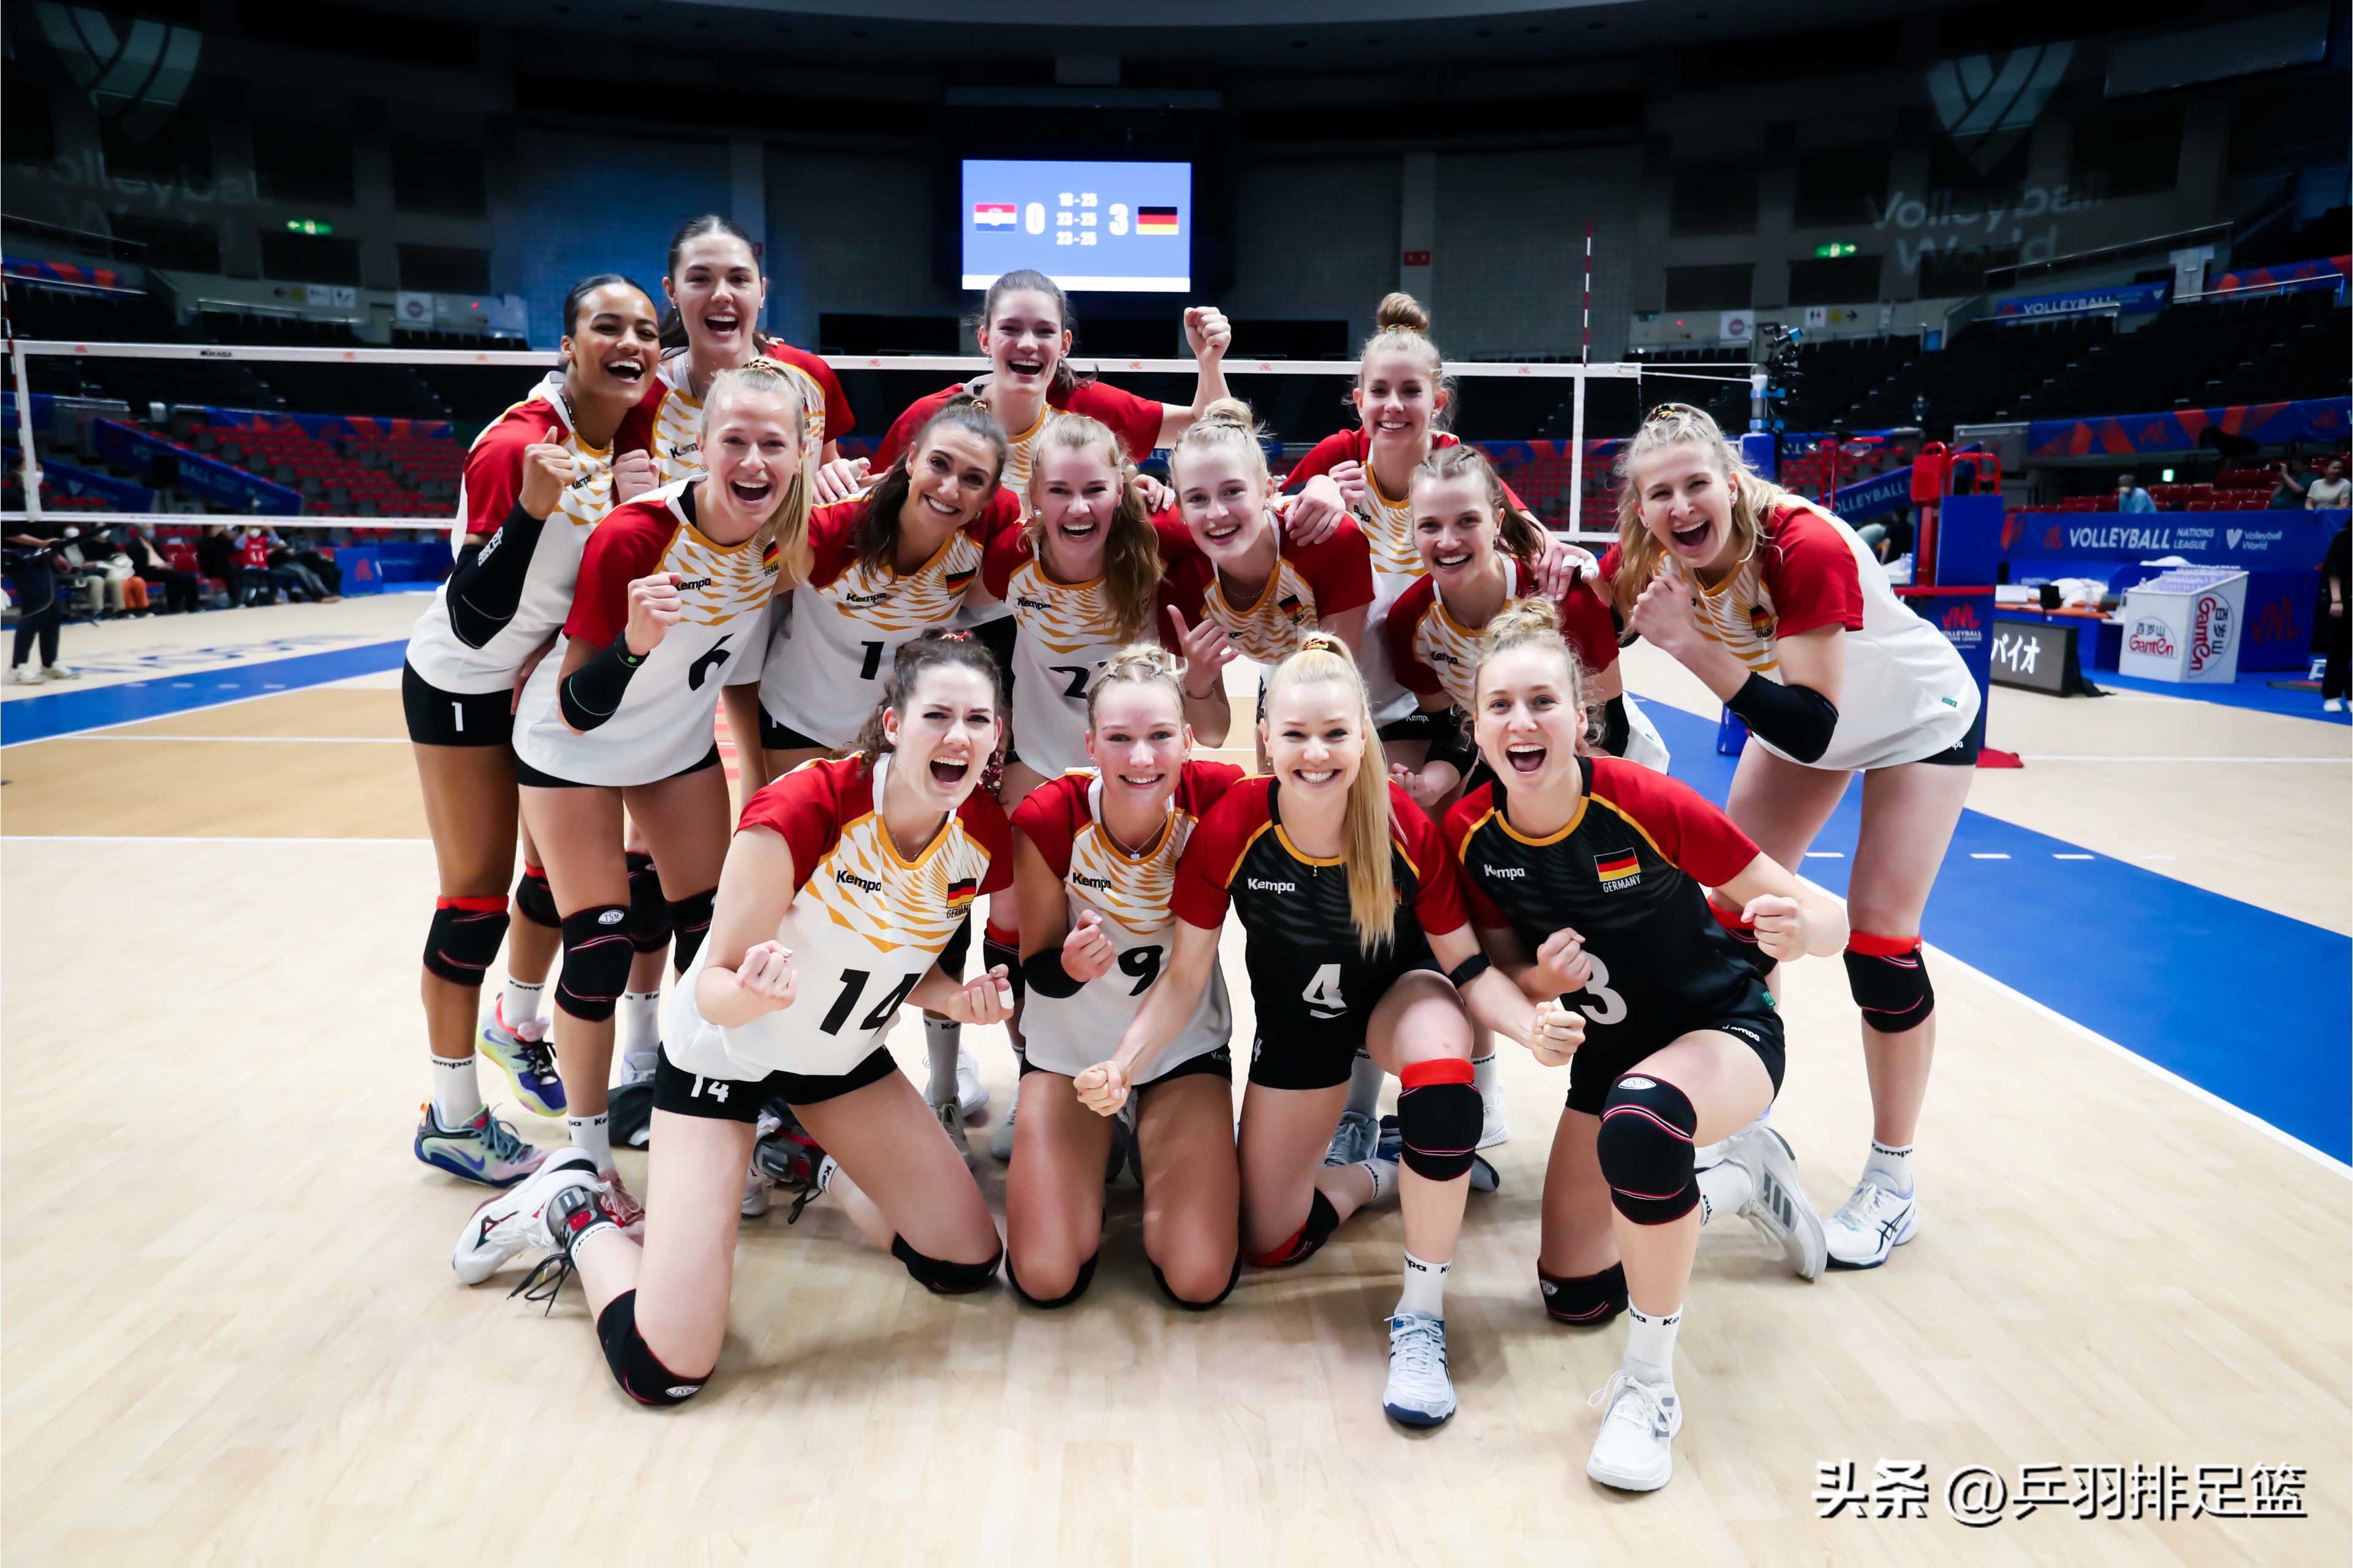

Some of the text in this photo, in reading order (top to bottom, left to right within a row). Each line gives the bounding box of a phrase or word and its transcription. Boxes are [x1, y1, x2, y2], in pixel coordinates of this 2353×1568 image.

[1025, 202, 1045, 235] 0
[1108, 203, 1129, 236] 3
[669, 443, 699, 458] Kem
[1836, 481, 1905, 515] OLLEYBALL
[2069, 528, 2170, 550] VOLLEYBALL
[2177, 528, 2215, 538] NATIONS
[2244, 530, 2283, 540] Volleyball
[2173, 539, 2207, 550] LEAGUE
[764, 562, 779, 577] GERM
[846, 593, 887, 603] Kempa
[1017, 597, 1051, 610] Kempa
[688, 632, 735, 692] 6
[860, 640, 885, 680] 1
[452, 702, 464, 732] 1
[836, 870, 882, 893] Kempa
[1072, 872, 1112, 892] Kempa
[1248, 878, 1295, 894] Kempa
[1603, 874, 1642, 893] GERMANY
[603, 912, 620, 922] TSM
[1117, 945, 1164, 996] 9
[1302, 963, 1348, 1019] 4
[819, 968, 922, 1040] 14
[1254, 1037, 1263, 1062] 4
[431, 1059, 472, 1069] empa
[690, 1074, 730, 1104] 14
